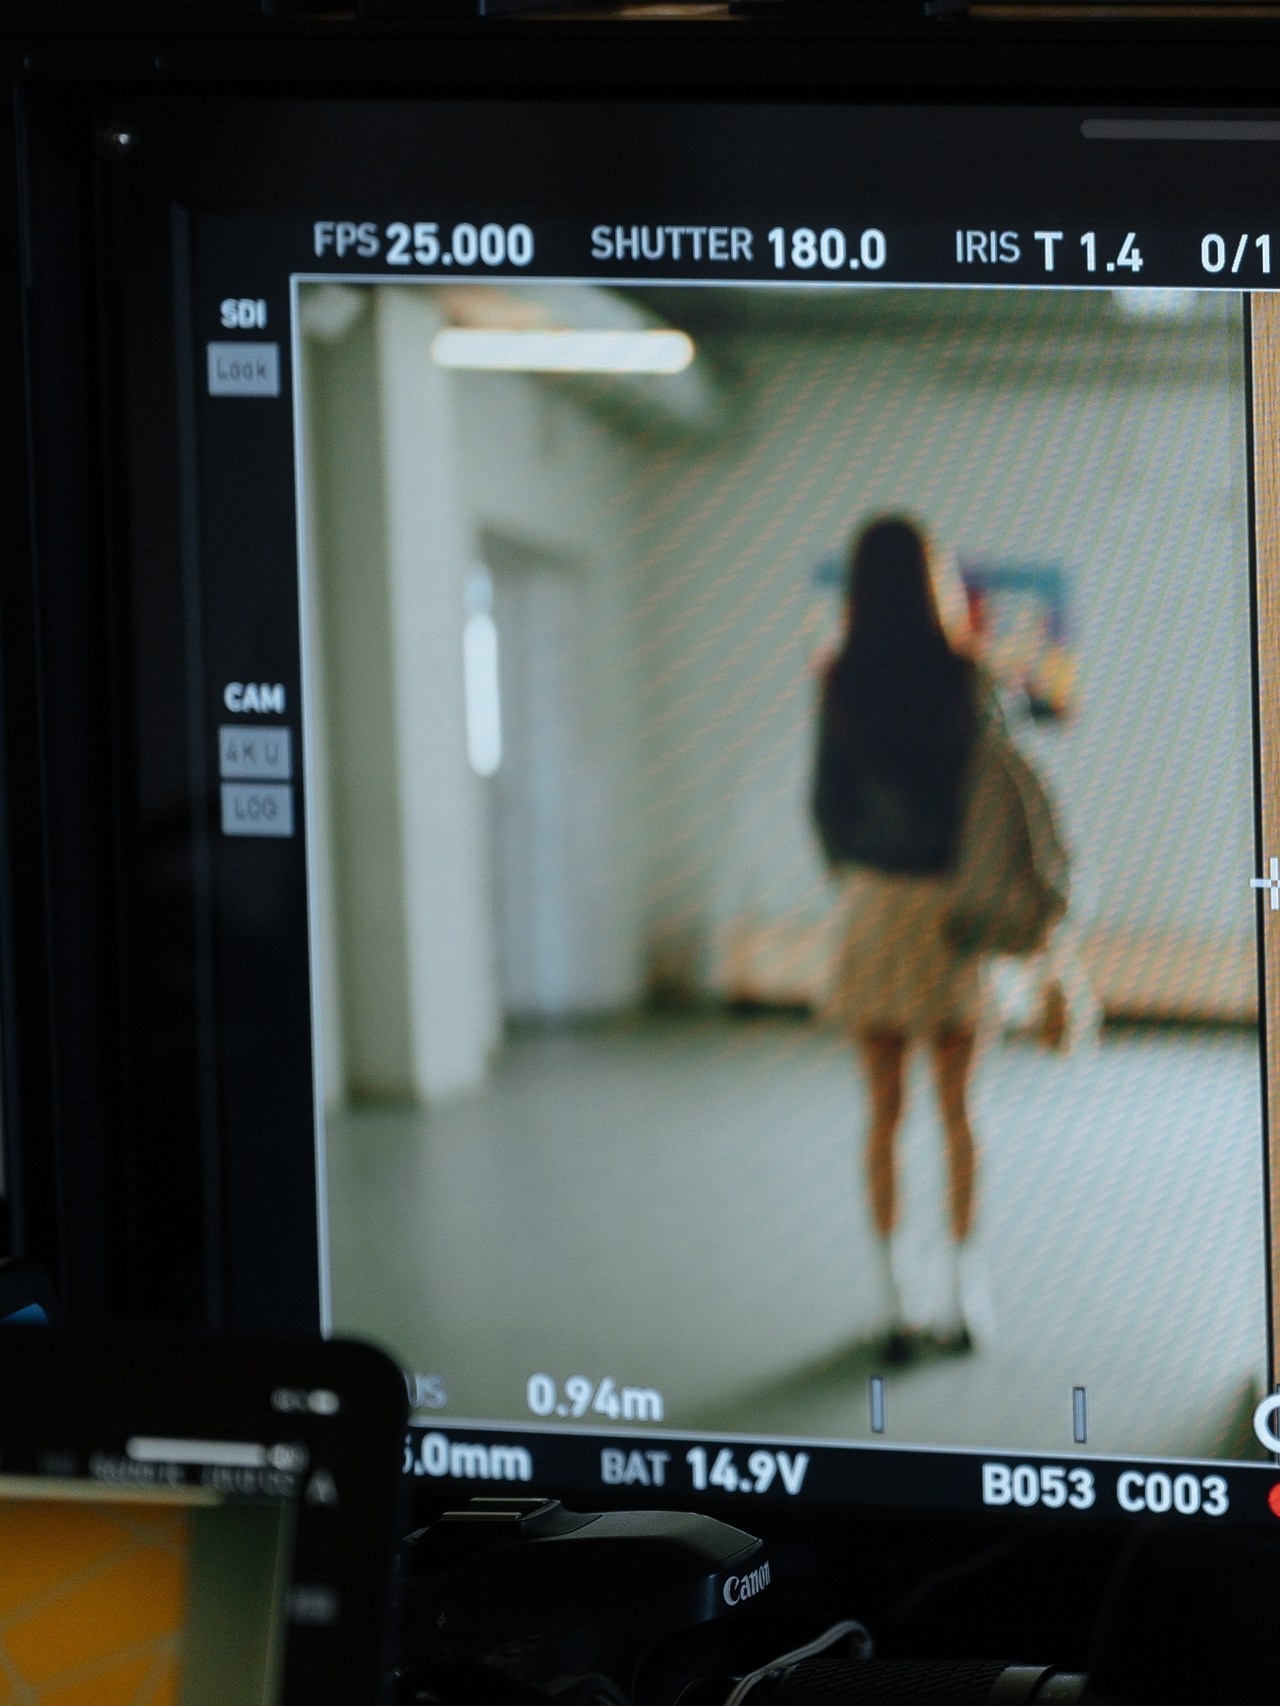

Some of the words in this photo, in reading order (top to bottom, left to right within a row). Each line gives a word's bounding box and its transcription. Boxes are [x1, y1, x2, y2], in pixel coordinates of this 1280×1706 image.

[314, 222, 380, 257] FPS
[386, 222, 533, 266] 25.000
[591, 226, 753, 261] SHUTTER
[768, 227, 886, 269] 180.0
[956, 230, 1021, 263] IRIS
[1034, 231, 1063, 271] T
[1081, 232, 1143, 272] 1.4
[221, 299, 266, 328] SDI
[224, 682, 285, 713] CAM
[527, 1373, 663, 1421] 0.94m
[601, 1449, 669, 1486] BAT
[686, 1447, 809, 1495] 14.9V
[982, 1463, 1095, 1509] B053
[1117, 1471, 1229, 1516] C003
[723, 1560, 770, 1606] Canon
